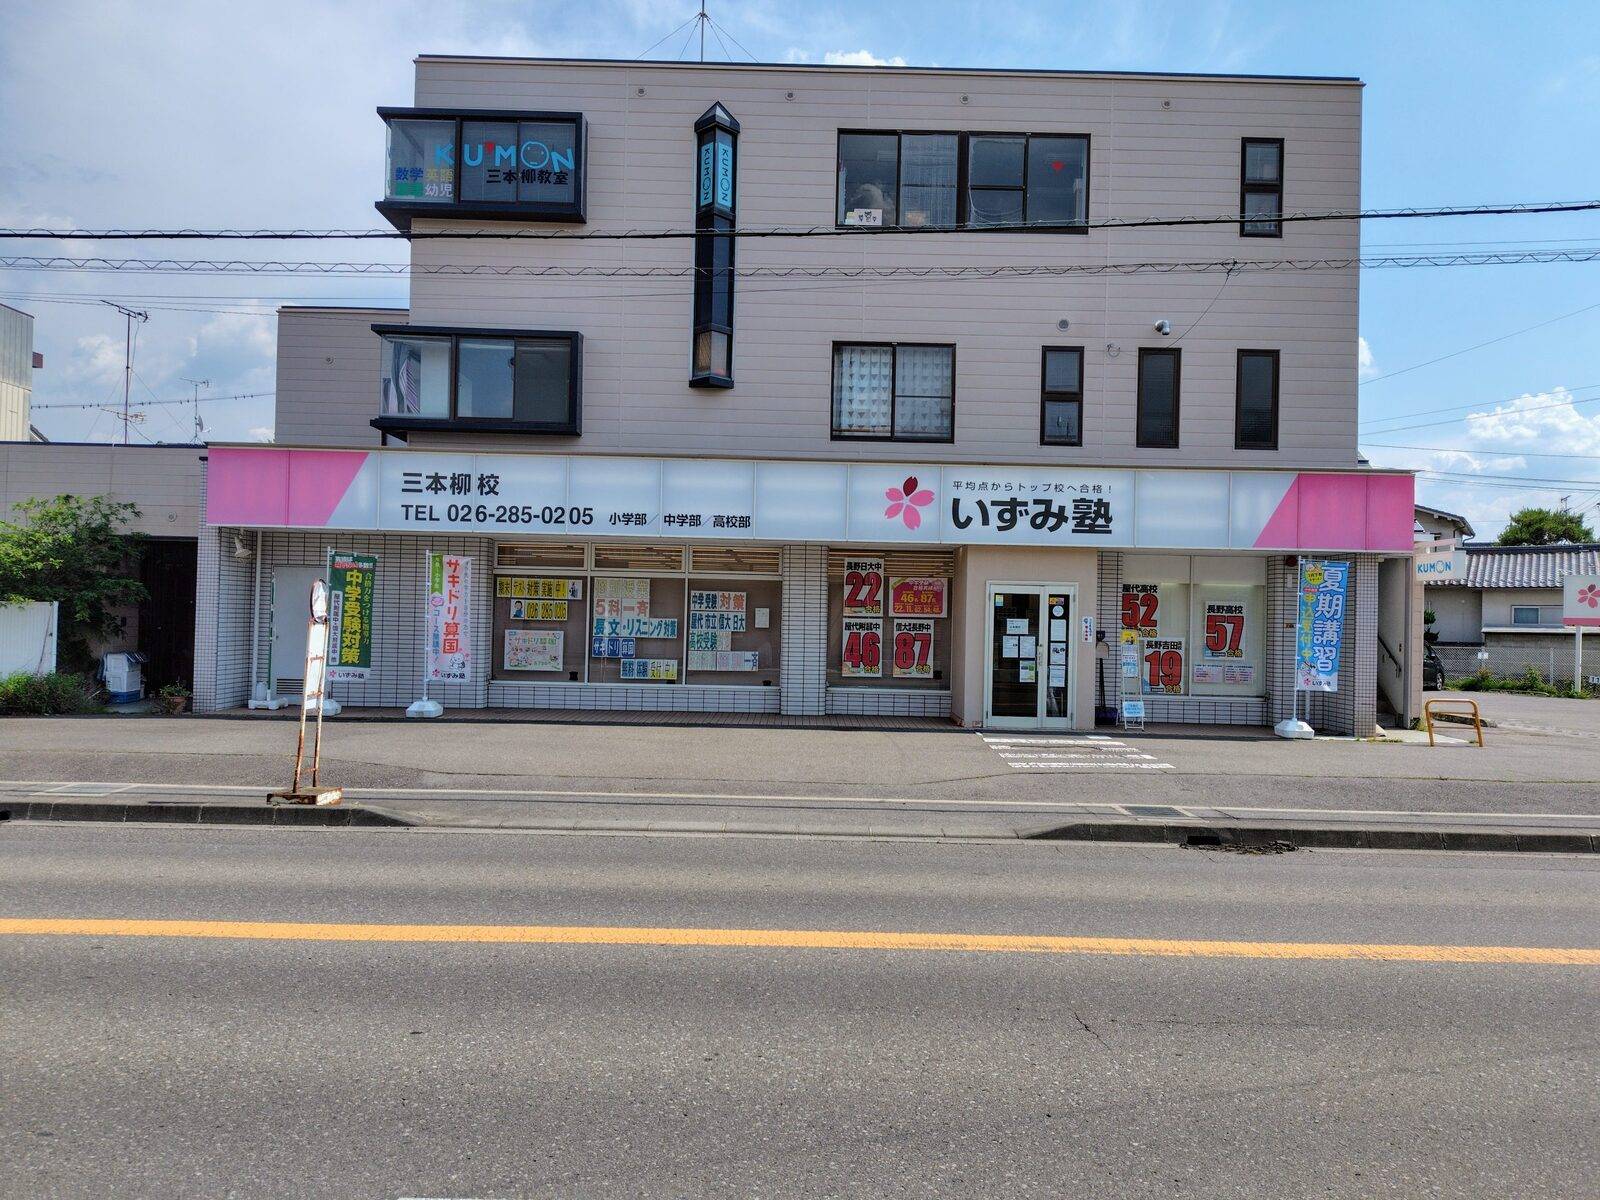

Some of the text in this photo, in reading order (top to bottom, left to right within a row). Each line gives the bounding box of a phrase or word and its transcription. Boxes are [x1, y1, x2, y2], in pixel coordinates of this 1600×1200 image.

[395, 167, 424, 181] 数学
[433, 141, 575, 172] KUMON
[702, 147, 712, 201] KUMON
[424, 183, 454, 197] 幼児
[486, 169, 568, 185] 三本柳教室
[720, 148, 731, 202] KUMON
[401, 504, 594, 525] TEL 026-285-0205
[951, 497, 1113, 534] いずみ塾
[846, 562, 882, 571] 長野日大中
[1417, 560, 1451, 573] KUMON
[844, 571, 882, 607] 22
[1122, 584, 1158, 593] 屋代高校
[341, 569, 362, 664] 中学受験対策
[1121, 593, 1159, 629] 52
[1207, 605, 1243, 614] 長野高校
[1313, 565, 1346, 673] 夏期講習
[844, 632, 880, 668] 46
[895, 632, 932, 669] 87
[1205, 614, 1245, 651] 57
[1144, 650, 1183, 687] 19
